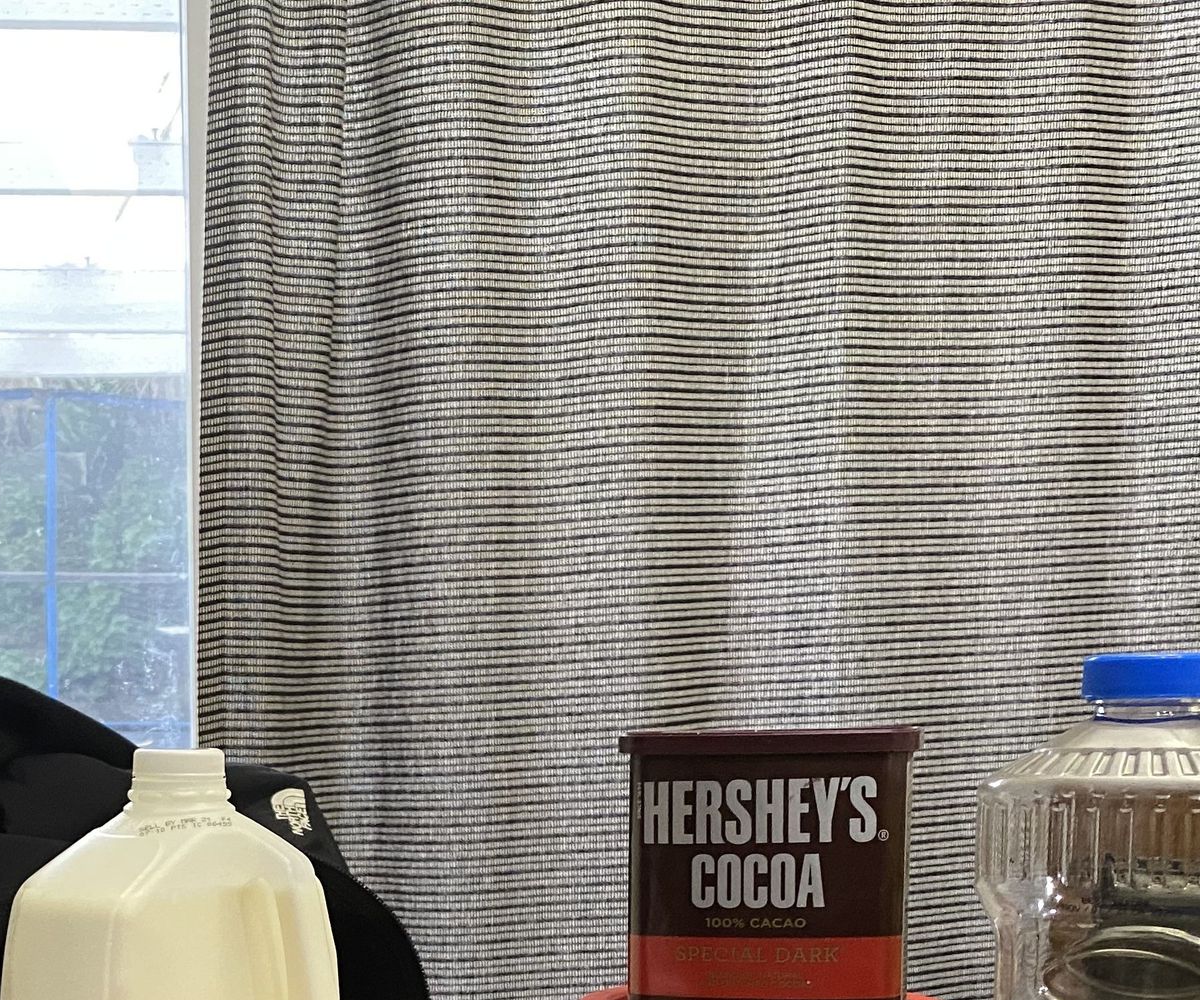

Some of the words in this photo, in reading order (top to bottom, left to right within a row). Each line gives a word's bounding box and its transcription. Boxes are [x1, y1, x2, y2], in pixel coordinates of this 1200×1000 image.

[643, 775, 877, 845] HERSHEY'S
[691, 853, 826, 909] COCOA
[705, 917, 745, 928] 100%
[750, 917, 807, 928] CACAO
[675, 946, 768, 963] SPECIAL
[776, 946, 840, 963] DARK
